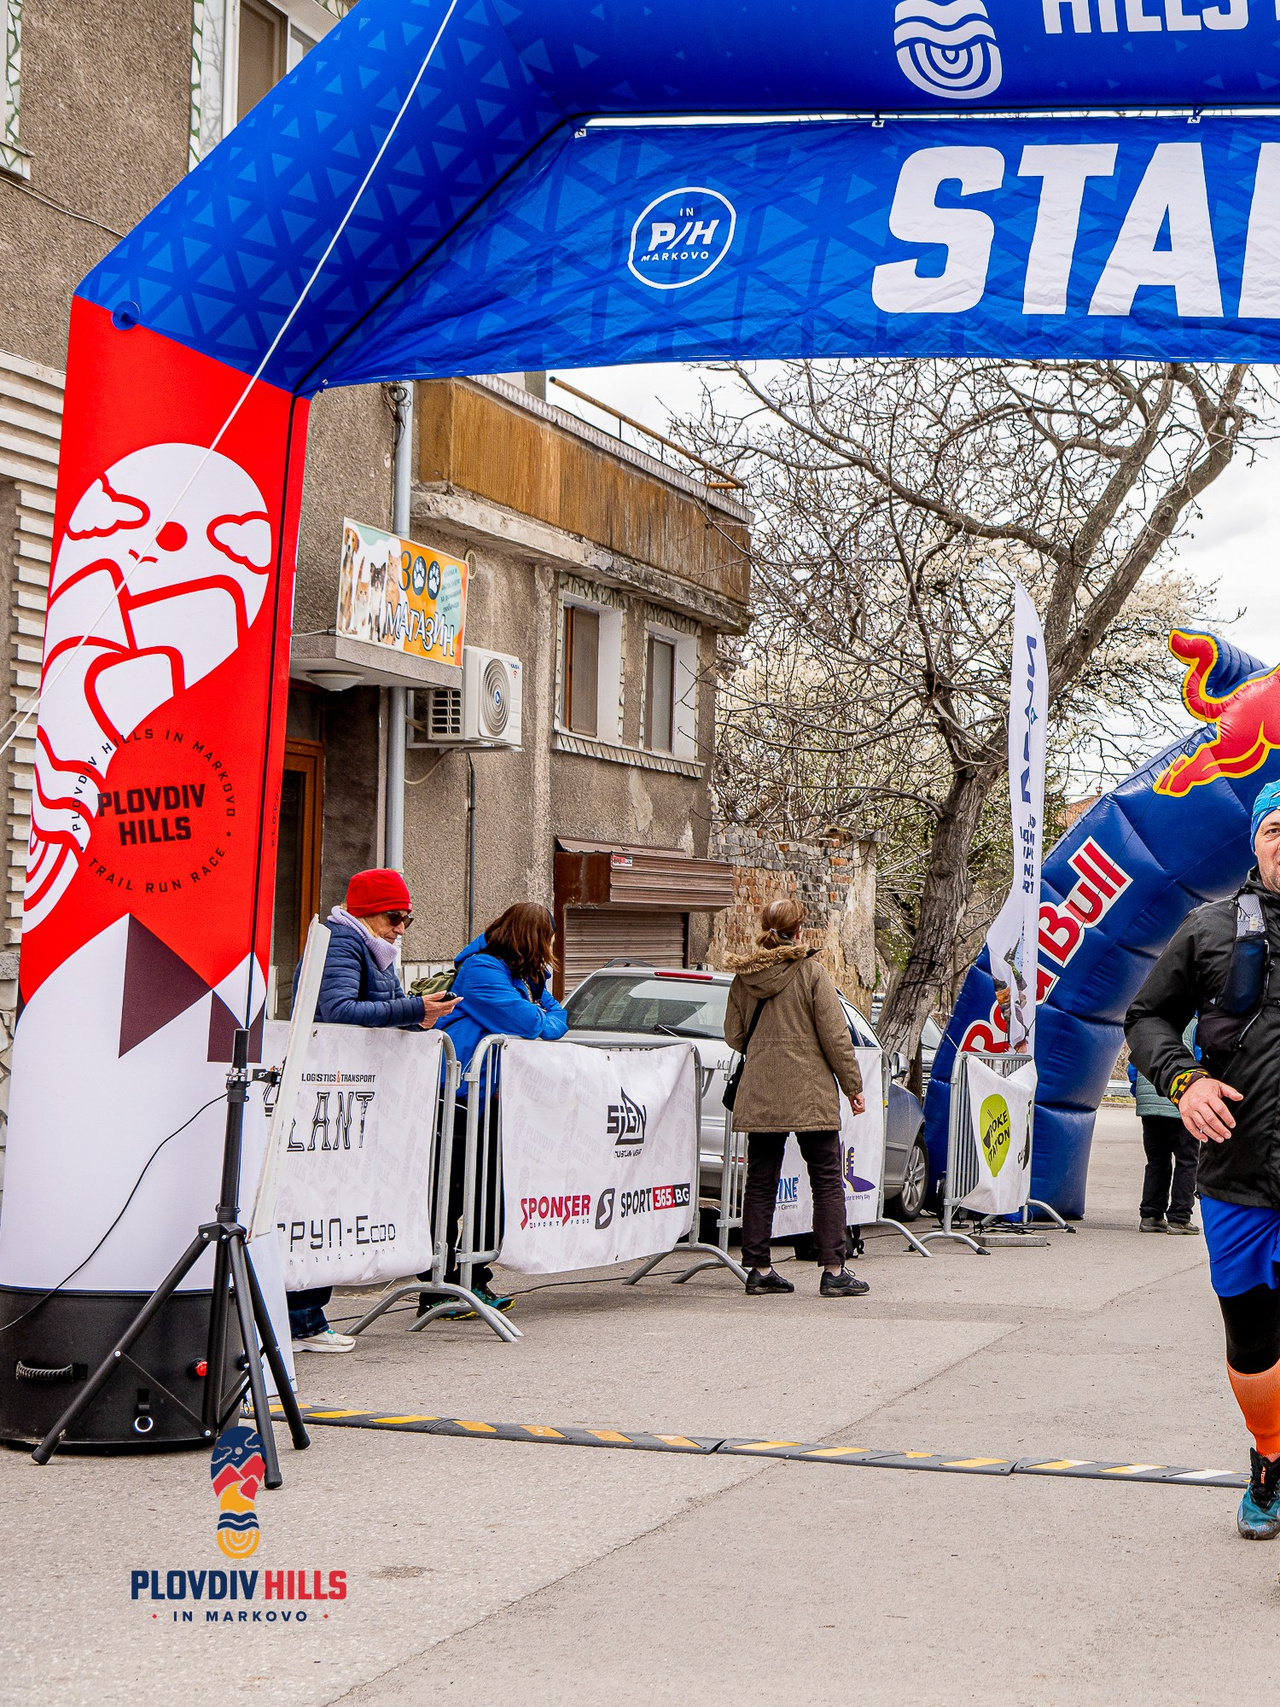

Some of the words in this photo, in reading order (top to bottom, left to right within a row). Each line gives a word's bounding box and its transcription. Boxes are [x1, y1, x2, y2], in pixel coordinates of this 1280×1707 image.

[679, 207, 694, 217] IN
[648, 219, 720, 252] P/H
[640, 251, 709, 262] MARKOVO
[384, 601, 455, 657] МАГАЗИН
[71, 756, 97, 831] PLOVDIV
[102, 729, 153, 754] HILLS
[165, 730, 184, 743] IN
[192, 741, 236, 817] MARKOVO
[97, 784, 205, 817] PLOVDIV
[118, 816, 192, 846] HILLS
[88, 858, 133, 891] TRAIL
[145, 879, 182, 893] RUN
[190, 847, 226, 883] RACE
[1038, 842, 1127, 962] Bull
[301, 1073, 336, 1082] LOGISTICS
[341, 1073, 376, 1083] TRANSPORT
[286, 1091, 375, 1152] LANT
[778, 1177, 799, 1200] INE
[520, 1194, 591, 1230] SPONSER
